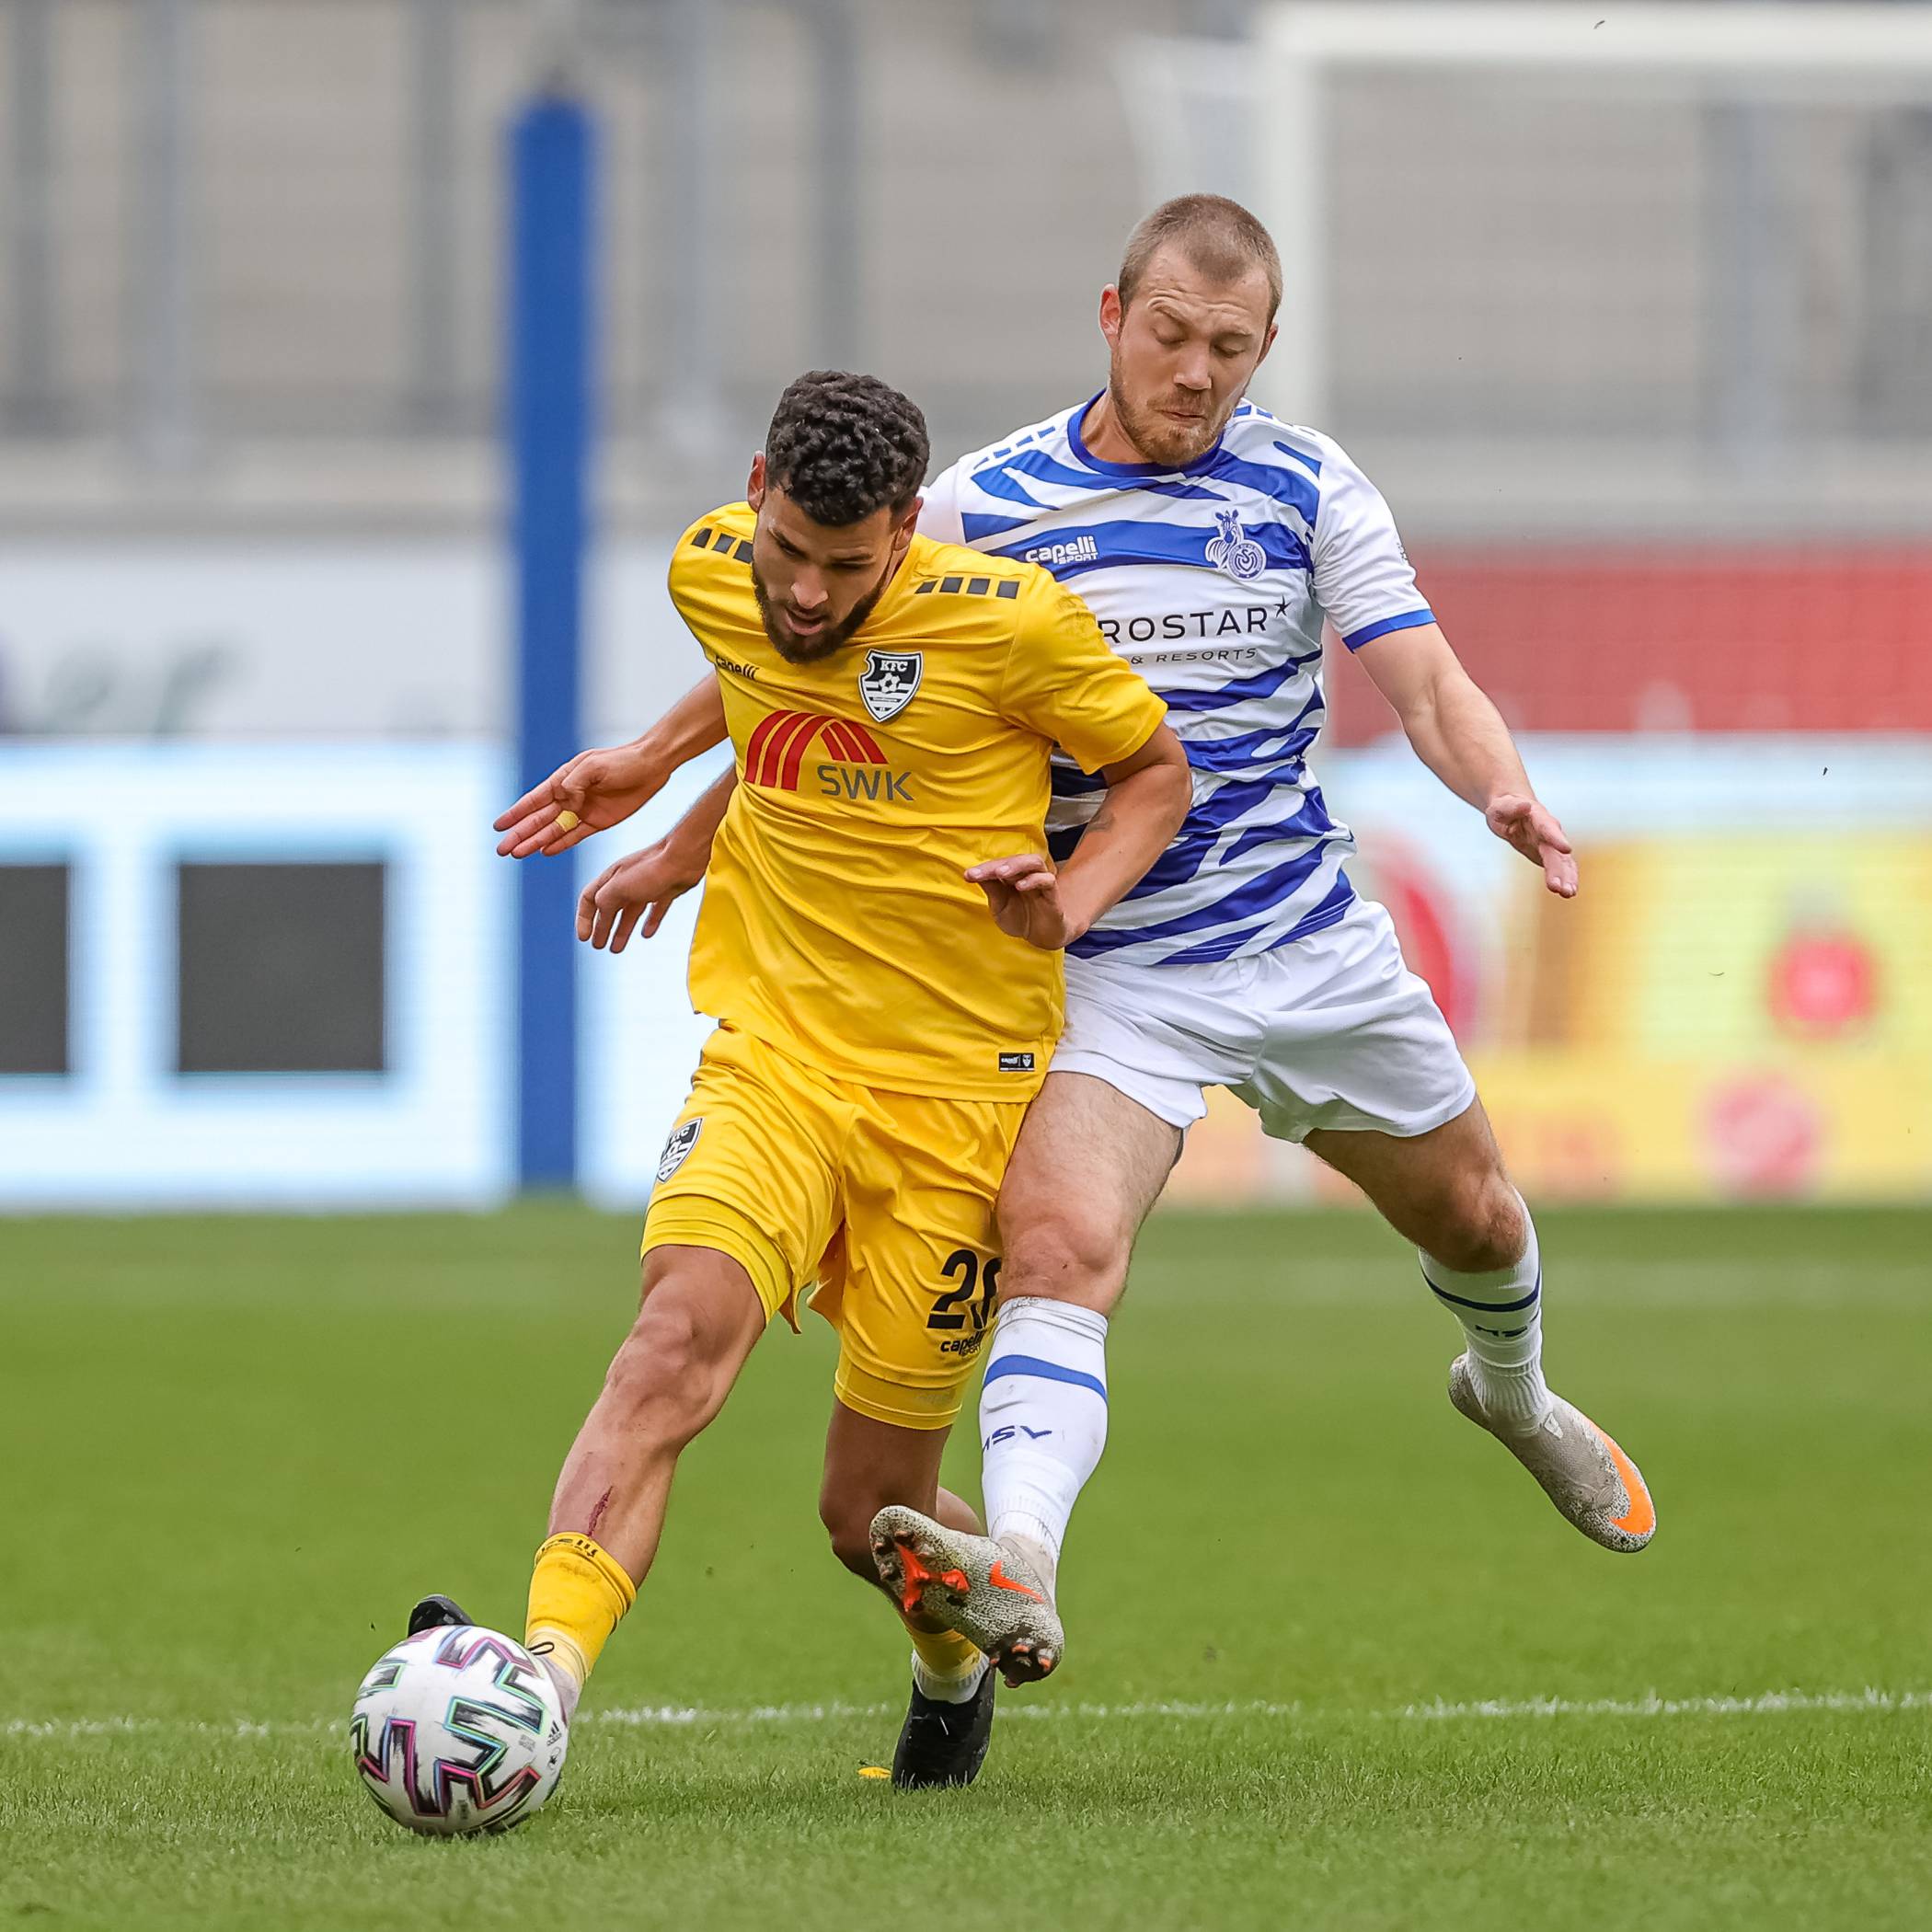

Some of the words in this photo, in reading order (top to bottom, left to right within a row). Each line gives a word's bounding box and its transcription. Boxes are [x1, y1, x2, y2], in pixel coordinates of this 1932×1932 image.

[1025, 535, 1098, 564] capelli
[1058, 552, 1098, 565] SPORT
[1131, 655, 1144, 665] &
[1156, 648, 1257, 662] RESORTS
[880, 660, 908, 673] KFC
[817, 765, 914, 801] SWK
